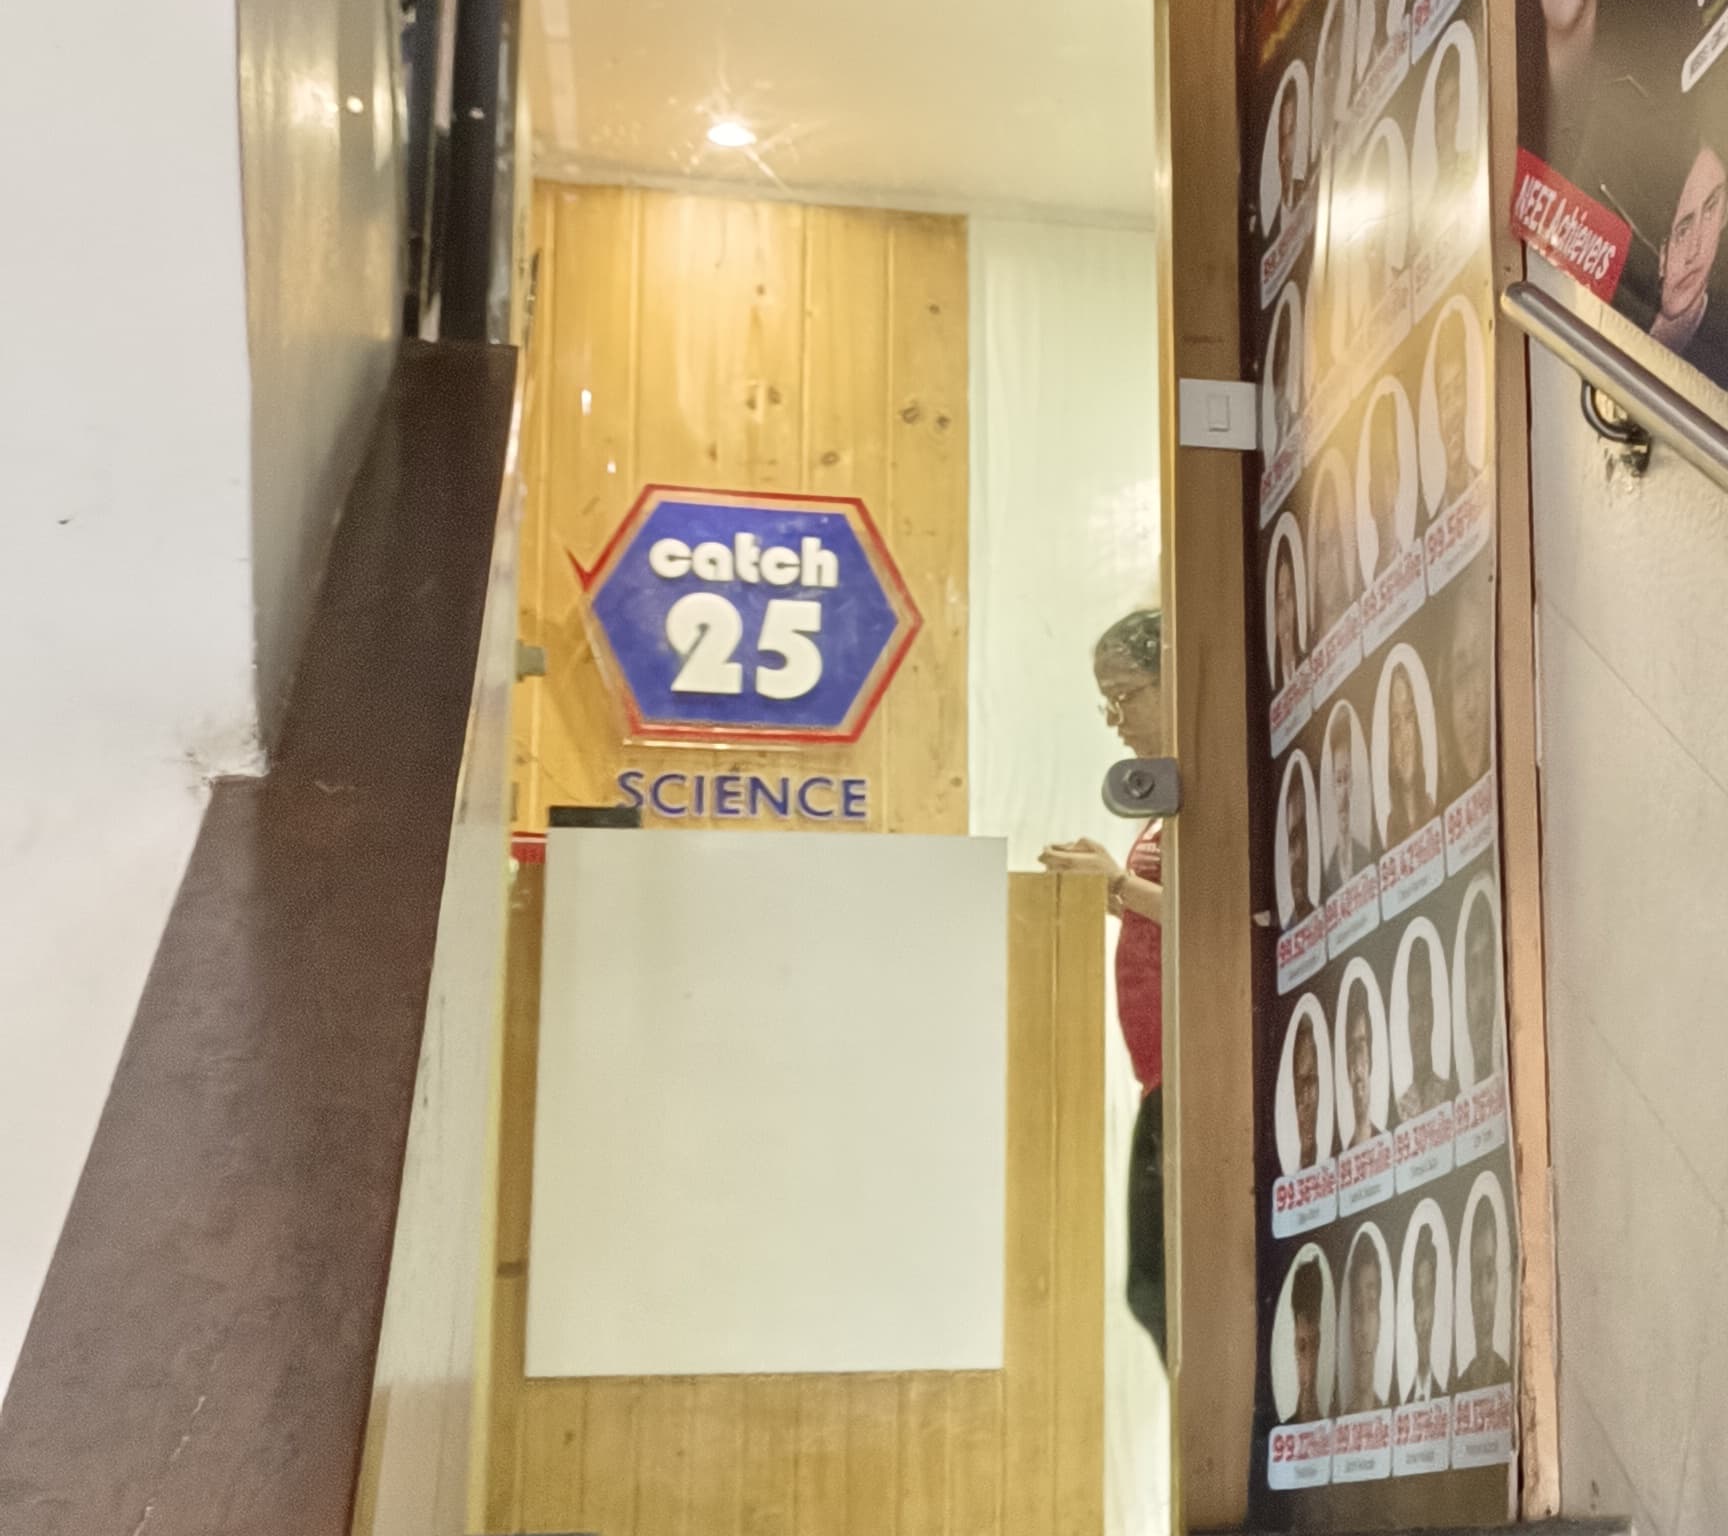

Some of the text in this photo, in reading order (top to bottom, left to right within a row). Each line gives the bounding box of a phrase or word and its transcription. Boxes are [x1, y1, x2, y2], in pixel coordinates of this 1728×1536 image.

[1514, 172, 1617, 280] NEET Achievers
[648, 531, 840, 589] catch
[664, 591, 824, 701] 25
[615, 769, 867, 820] SCIENCE
